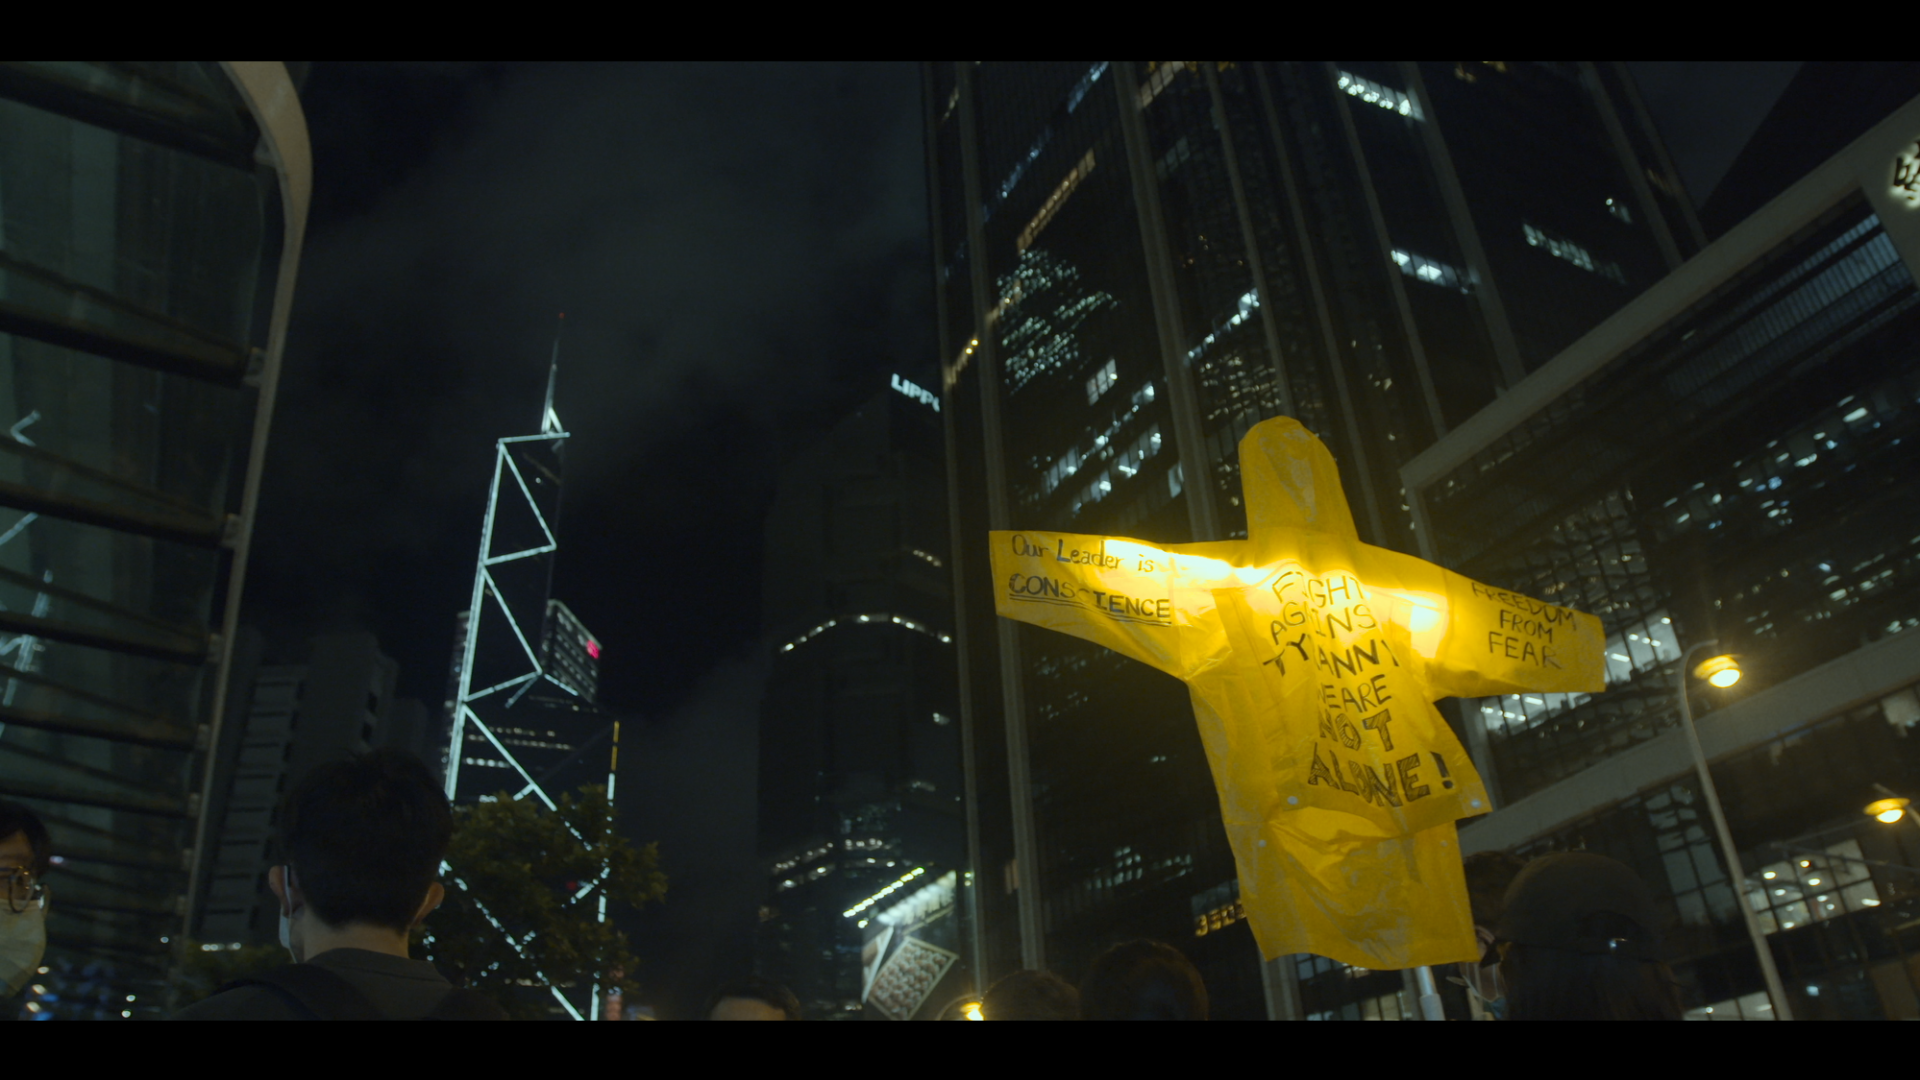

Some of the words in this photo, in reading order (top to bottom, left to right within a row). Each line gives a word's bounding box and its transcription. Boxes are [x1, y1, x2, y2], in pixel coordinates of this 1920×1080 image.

[1012, 534, 1048, 557] Our
[1056, 539, 1124, 569] Leader
[1138, 554, 1155, 572] is
[1500, 609, 1553, 644] FROM
[1488, 631, 1562, 670] FEAR
[1318, 708, 1395, 752] NOT
